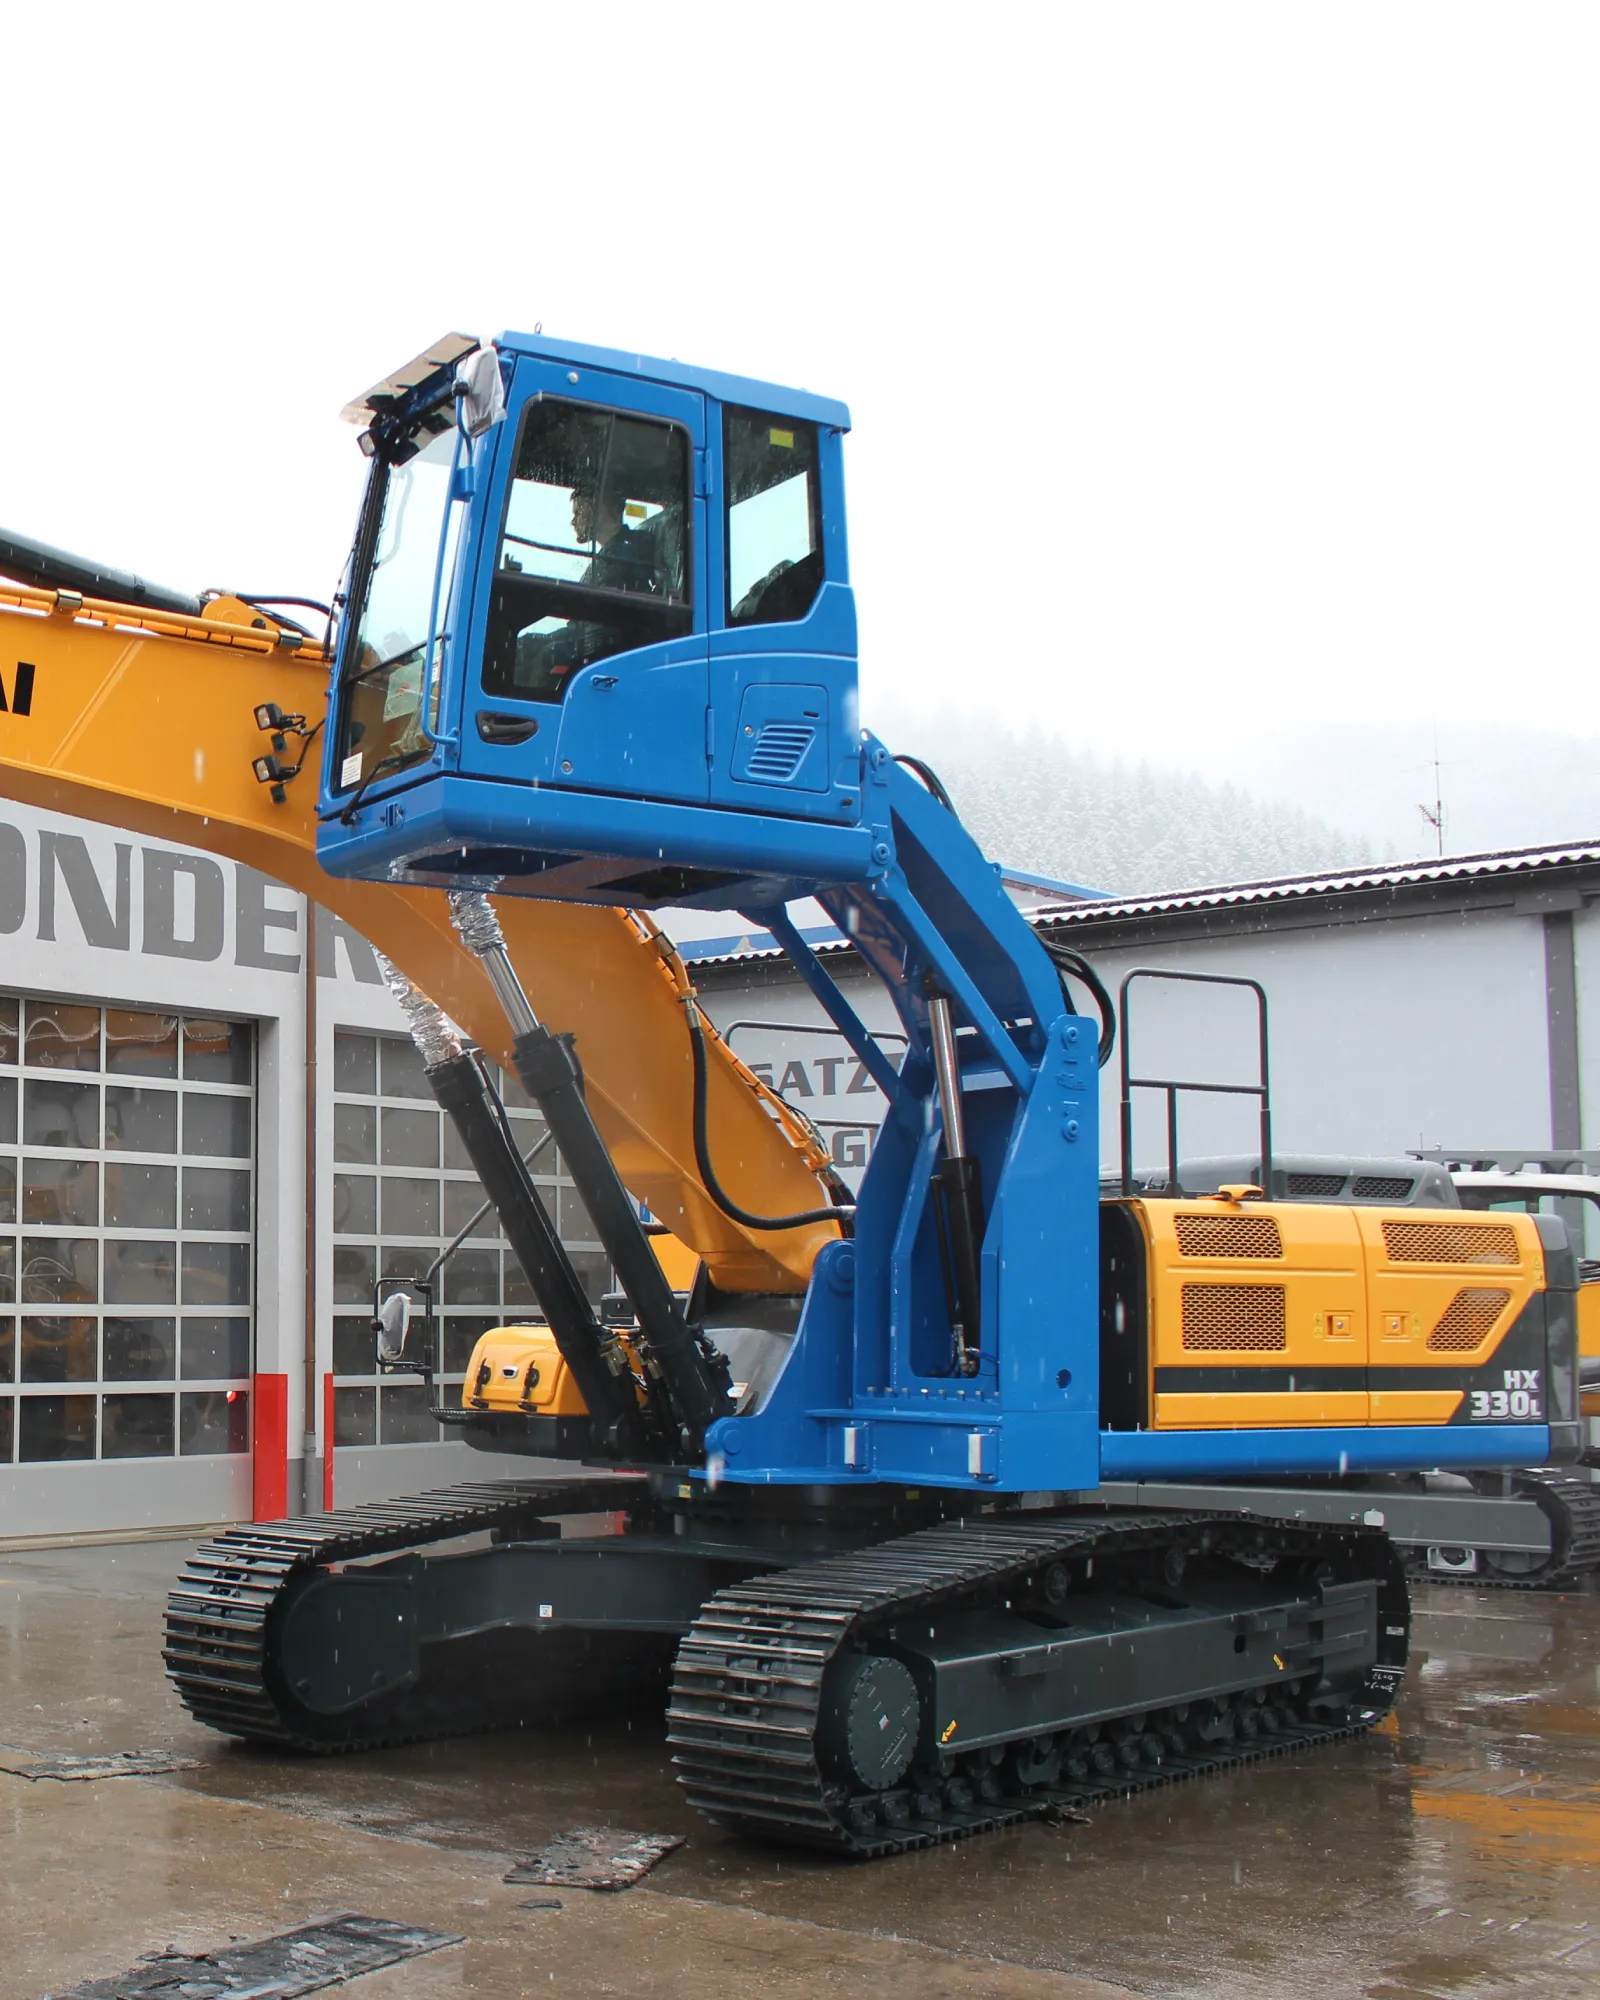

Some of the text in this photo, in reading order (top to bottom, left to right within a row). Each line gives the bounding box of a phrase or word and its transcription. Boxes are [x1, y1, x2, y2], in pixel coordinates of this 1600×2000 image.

[0, 662, 36, 716] I
[1503, 1370, 1540, 1390] HX
[1470, 1390, 1542, 1420] 330L
